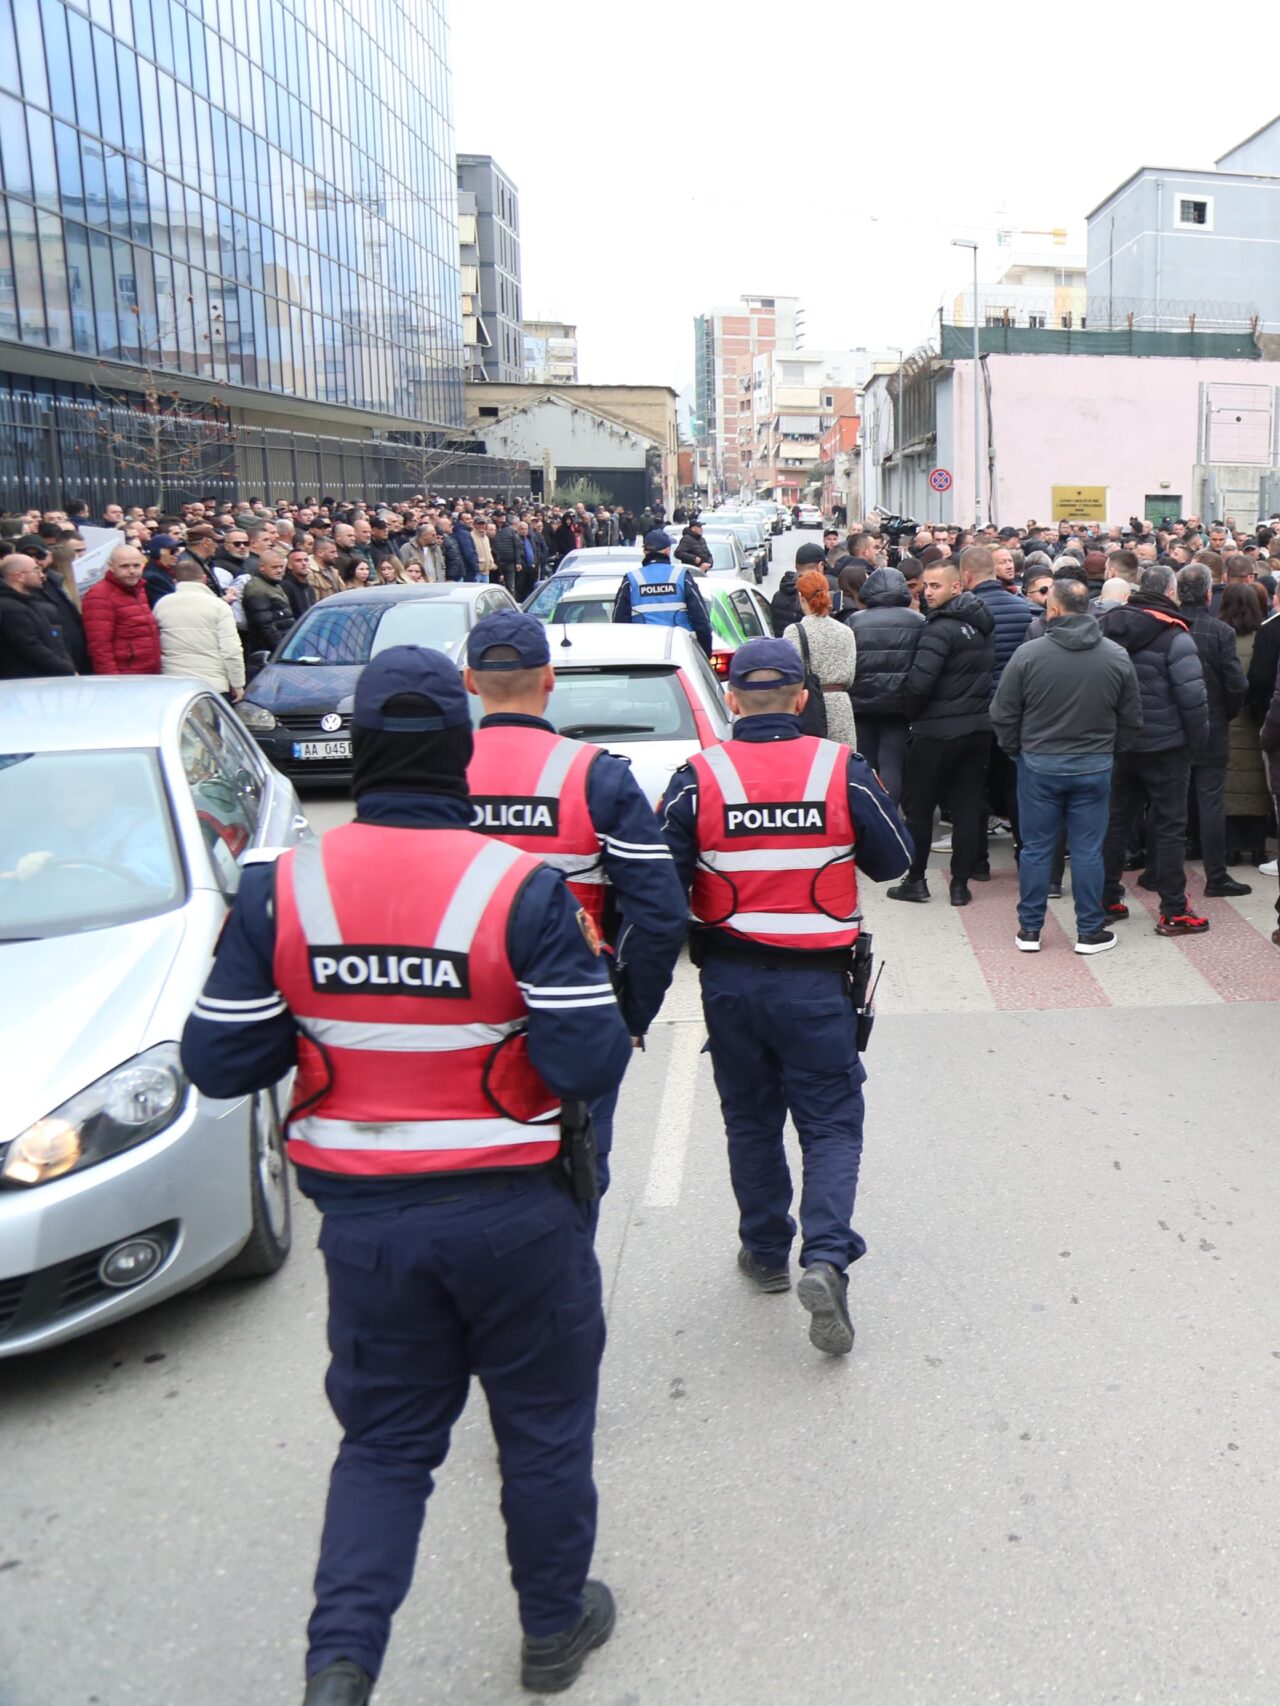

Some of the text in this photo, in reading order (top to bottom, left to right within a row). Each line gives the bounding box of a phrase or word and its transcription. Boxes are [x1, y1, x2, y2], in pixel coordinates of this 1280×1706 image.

[641, 585, 675, 594] POLICIA
[304, 743, 318, 756] AA
[324, 742, 346, 755] 045
[469, 805, 553, 827] OLICIA
[727, 808, 823, 830] POLICIA
[313, 955, 462, 988] POLICIA
